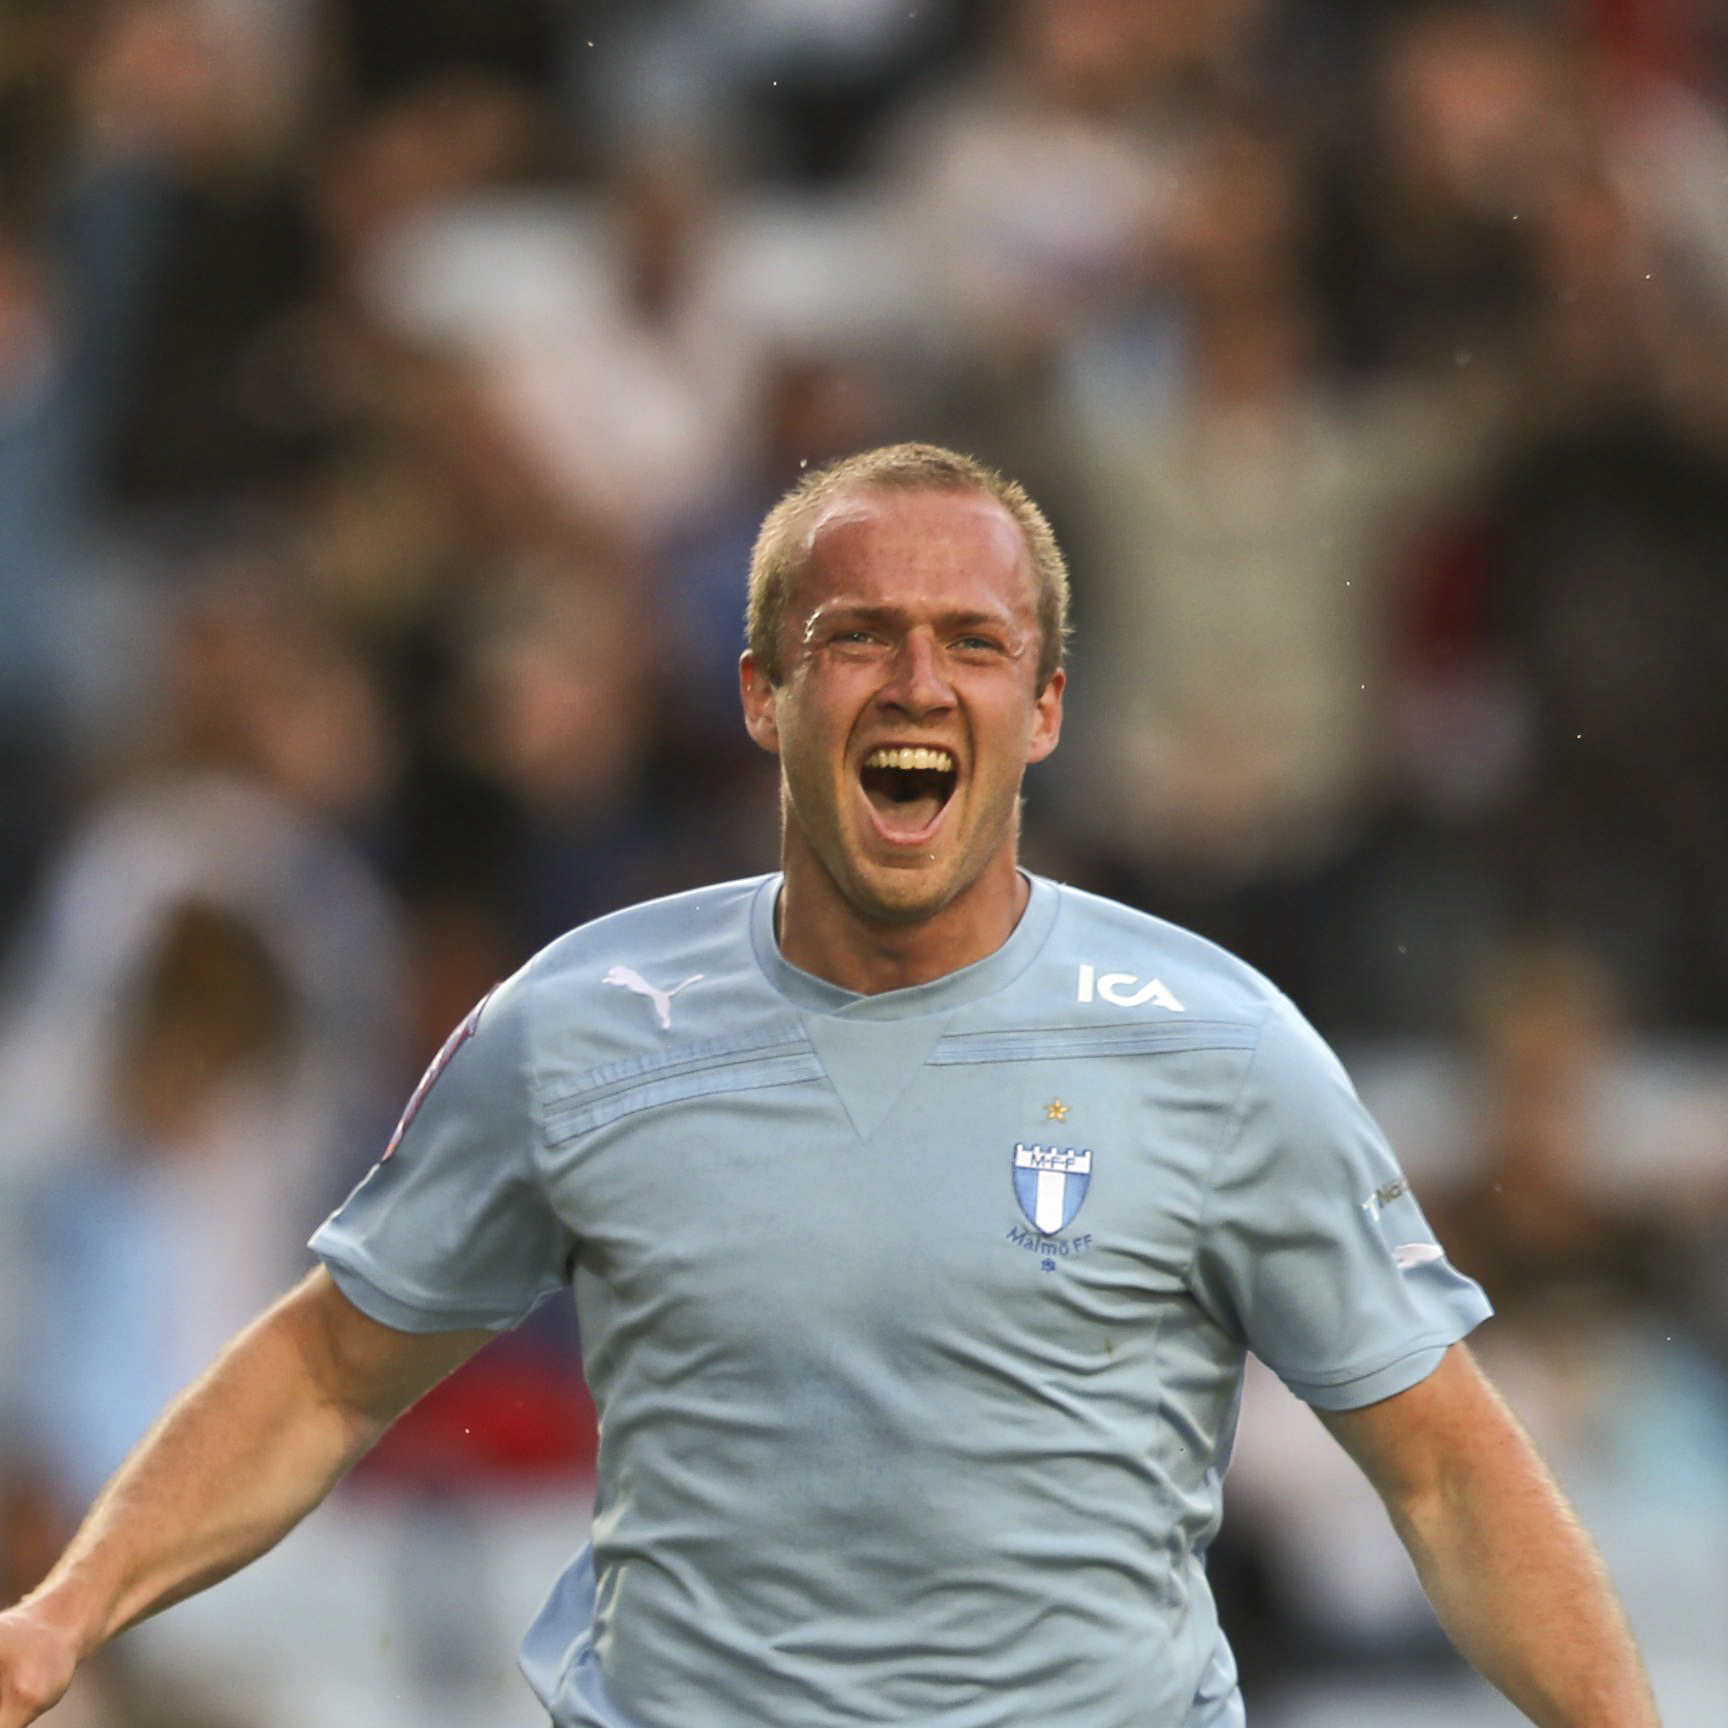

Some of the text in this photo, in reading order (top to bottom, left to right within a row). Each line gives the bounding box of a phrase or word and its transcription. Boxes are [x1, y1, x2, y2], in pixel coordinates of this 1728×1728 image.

[1076, 963, 1185, 1012] ICA
[1005, 1226, 1093, 1256] Malmö FF
